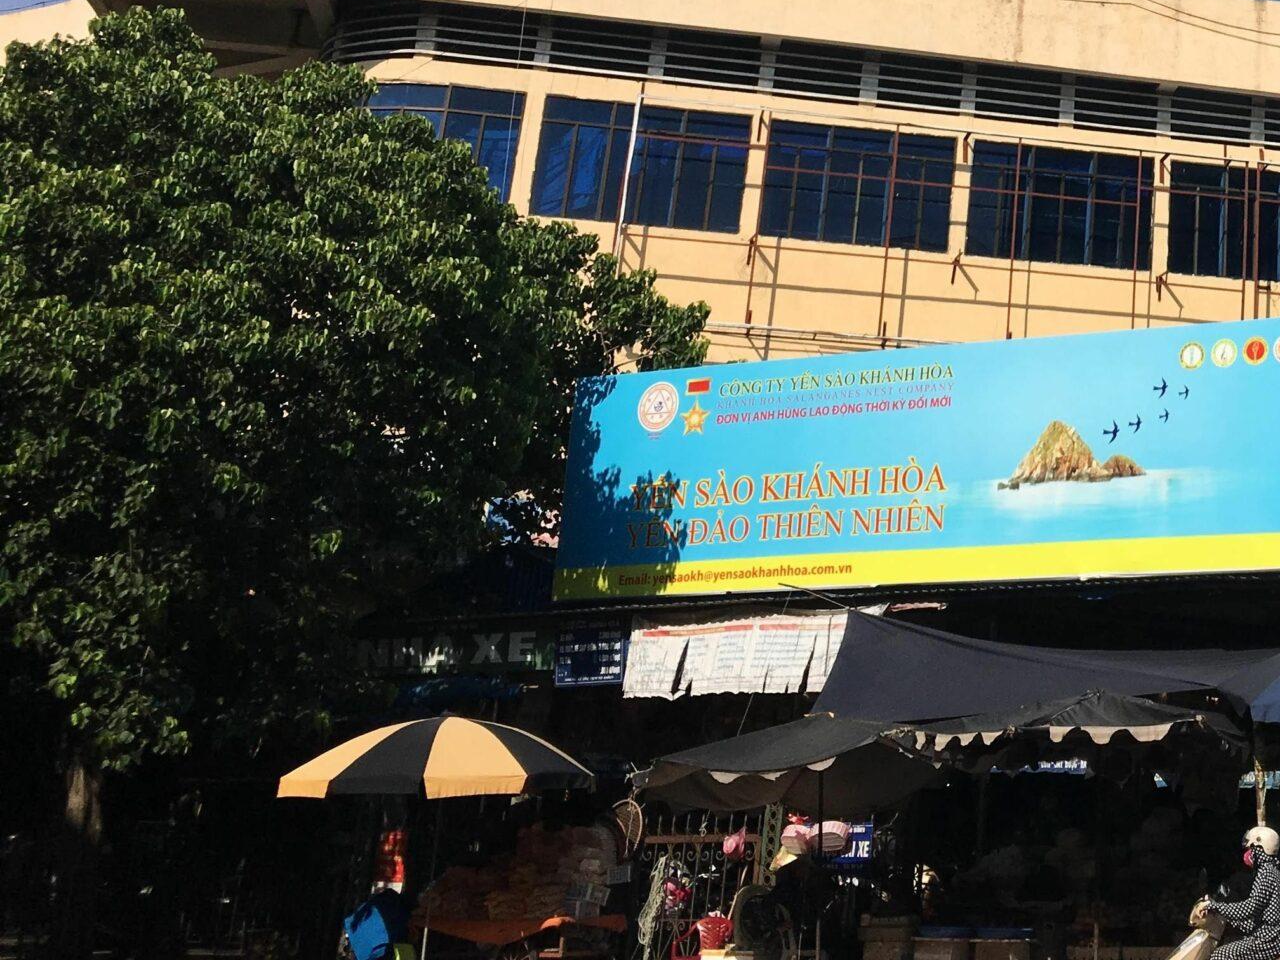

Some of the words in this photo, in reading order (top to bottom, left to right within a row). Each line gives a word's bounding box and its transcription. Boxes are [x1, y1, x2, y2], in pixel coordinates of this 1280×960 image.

[719, 377, 762, 397] CÔNG
[765, 377, 786, 393] TY
[790, 370, 821, 391] YẾN
[824, 367, 856, 388] SÀO
[859, 364, 915, 385] KHÁNH
[918, 361, 954, 381] HÒA
[866, 385, 893, 397] NEST
[899, 382, 955, 396] COMPANY
[716, 411, 739, 425] ĐƠN
[752, 409, 775, 422] ANH
[777, 404, 807, 420] HÙNG
[809, 406, 830, 417] LAO
[832, 401, 863, 416] ĐỘNG
[865, 397, 890, 413] THỜI
[930, 393, 952, 408] MỚI
[694, 468, 755, 508] SÀO
[759, 463, 872, 503] KHÁNH
[877, 455, 948, 496] HÒA
[686, 510, 751, 547] ĐẢO
[756, 503, 845, 541] THIÊN
[850, 498, 946, 537] NHIÊN
[618, 574, 651, 587] Email:
[652, 563, 853, 587] yensaokh@yensaokhanhhoa.com.vn
